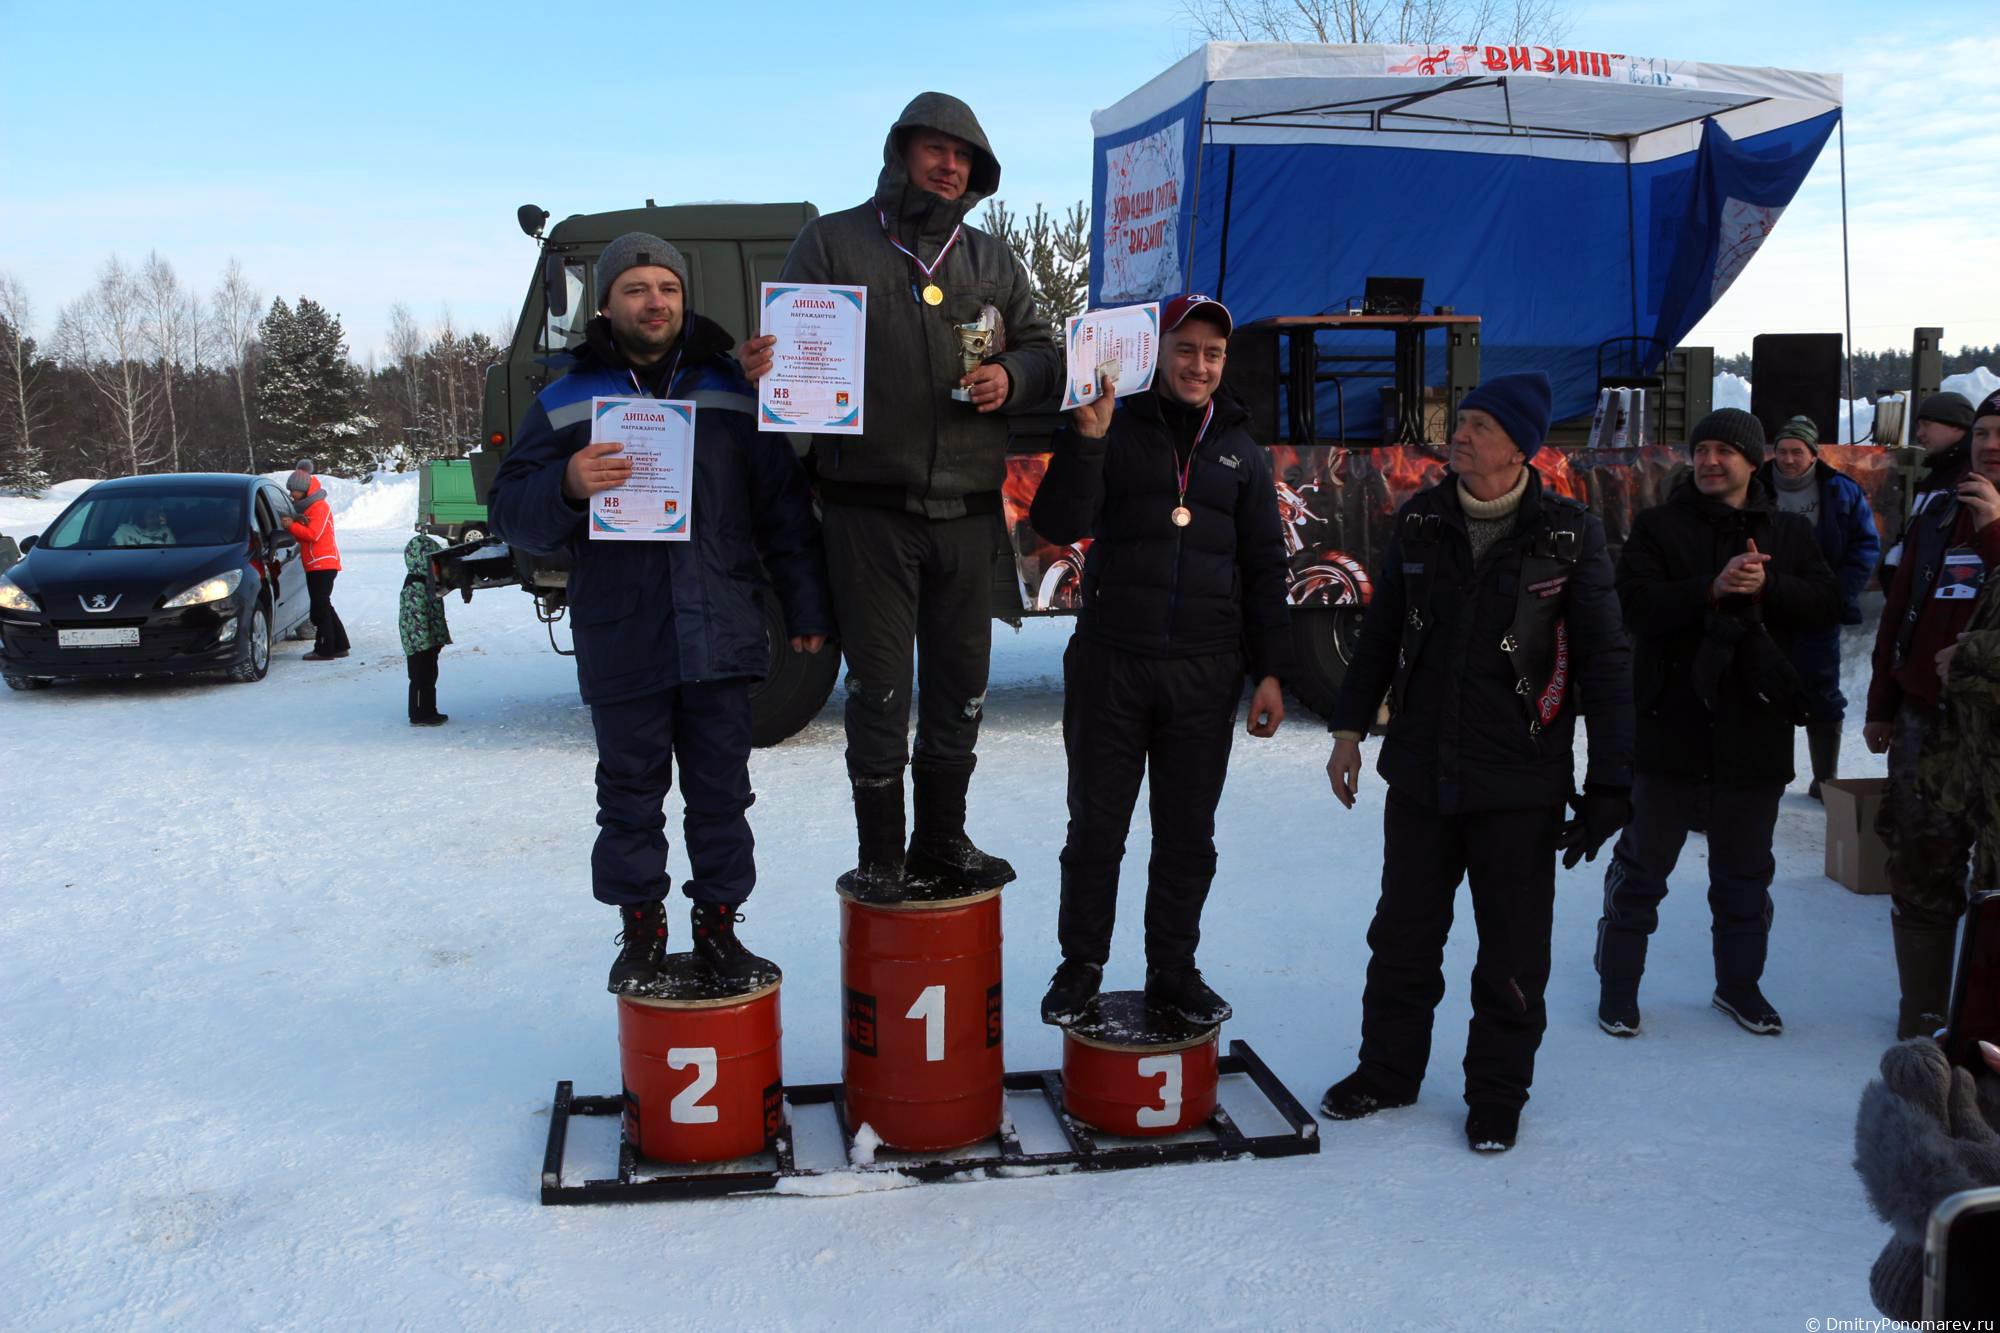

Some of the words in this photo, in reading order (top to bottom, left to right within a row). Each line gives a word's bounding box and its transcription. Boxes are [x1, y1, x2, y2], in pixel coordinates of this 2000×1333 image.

[792, 299, 835, 309] ДИПЛОМ
[1142, 331, 1150, 369] ДИПЛОМ
[622, 412, 665, 422] ДИПЛОМ
[905, 985, 945, 1061] 1
[667, 1047, 719, 1124] 2
[1136, 1053, 1183, 1128] 3
